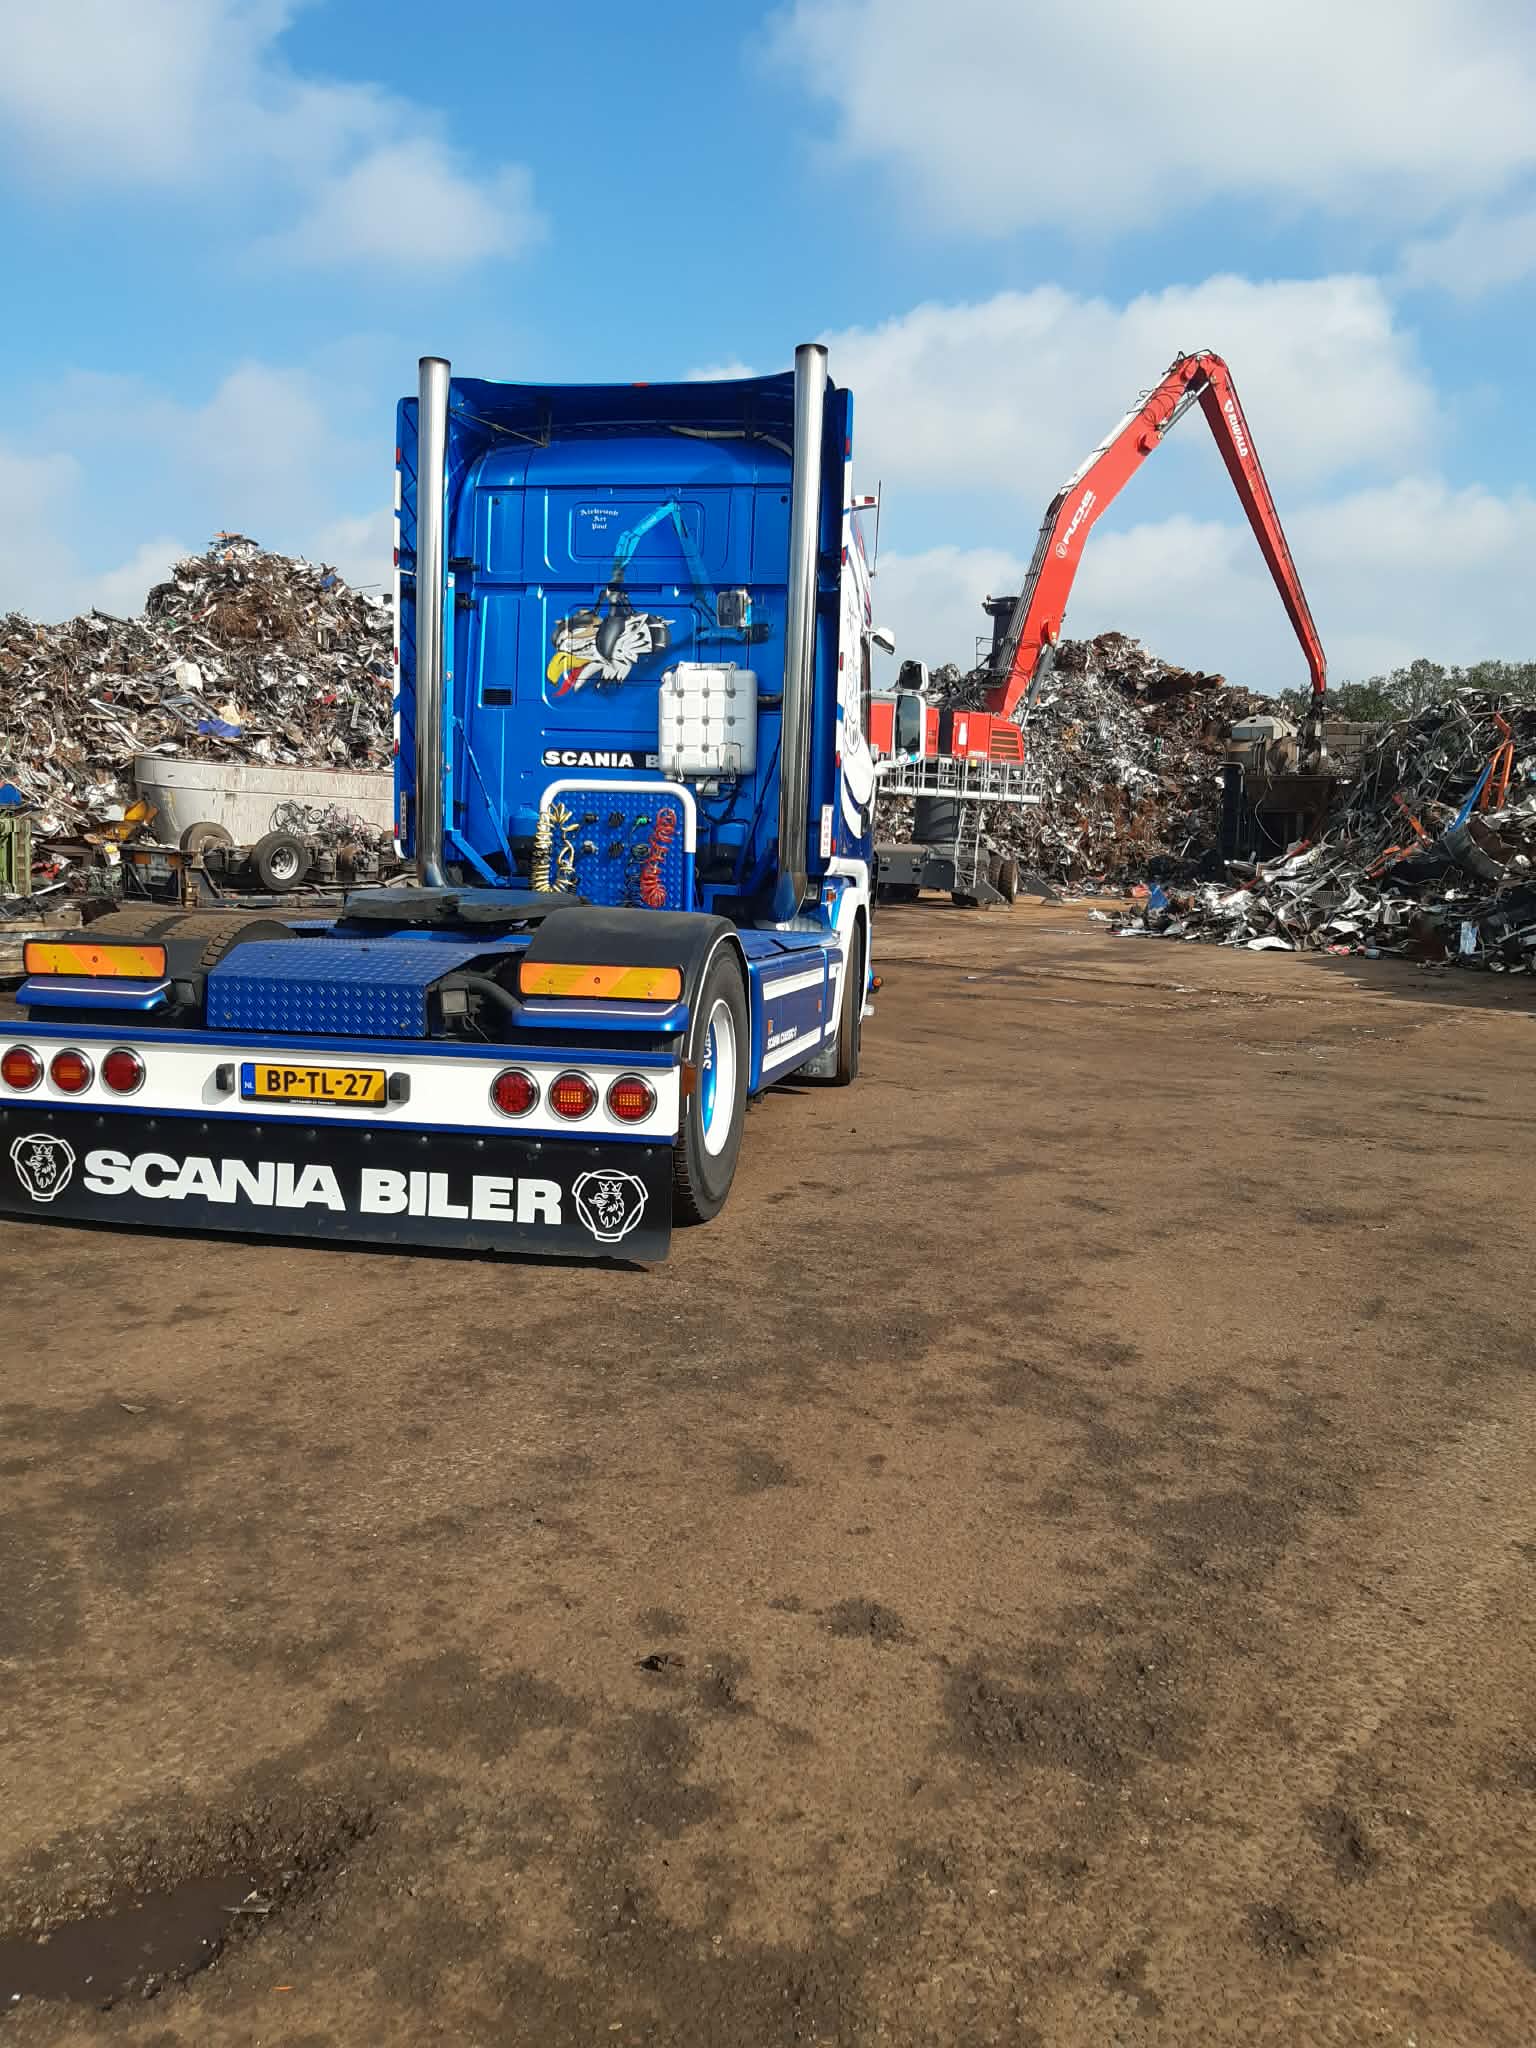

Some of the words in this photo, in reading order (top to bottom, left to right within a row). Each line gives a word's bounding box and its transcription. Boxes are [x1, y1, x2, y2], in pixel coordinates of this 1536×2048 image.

[545, 750, 635, 768] SCANIA
[645, 754, 660, 768] B
[244, 1081, 255, 1089] NL
[266, 1070, 374, 1097] BP-TL-27
[83, 1149, 347, 1212] SCANIA
[359, 1167, 563, 1226] BILER
